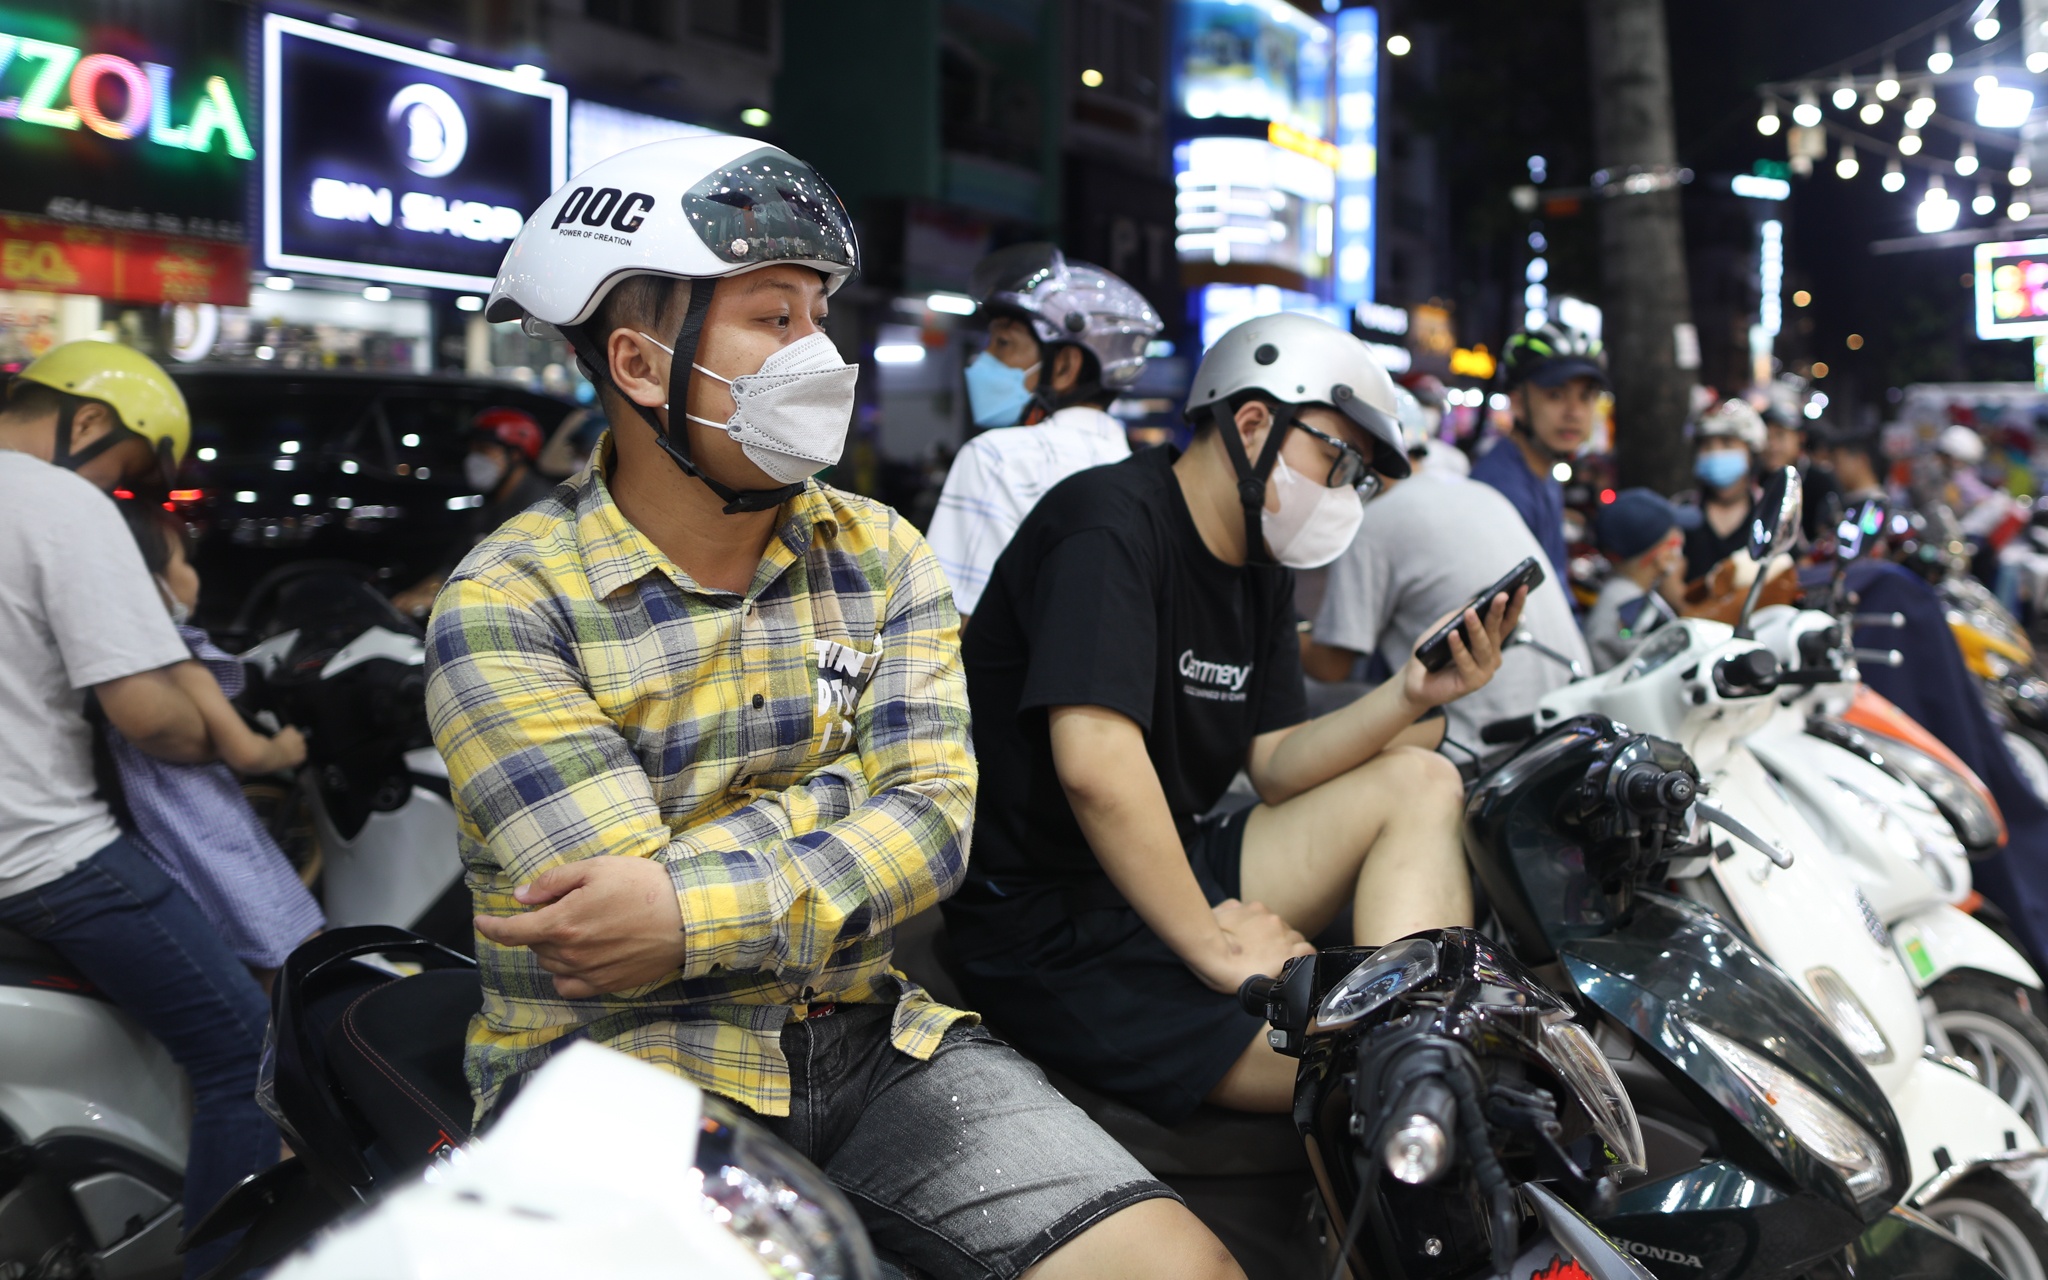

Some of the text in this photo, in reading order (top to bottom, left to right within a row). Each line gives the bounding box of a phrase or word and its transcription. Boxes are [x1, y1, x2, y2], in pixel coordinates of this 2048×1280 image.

[398, 191, 524, 244] SHOP
[559, 228, 632, 246] POWER OF CREATION
[1612, 1235, 1704, 1269] HONDA
